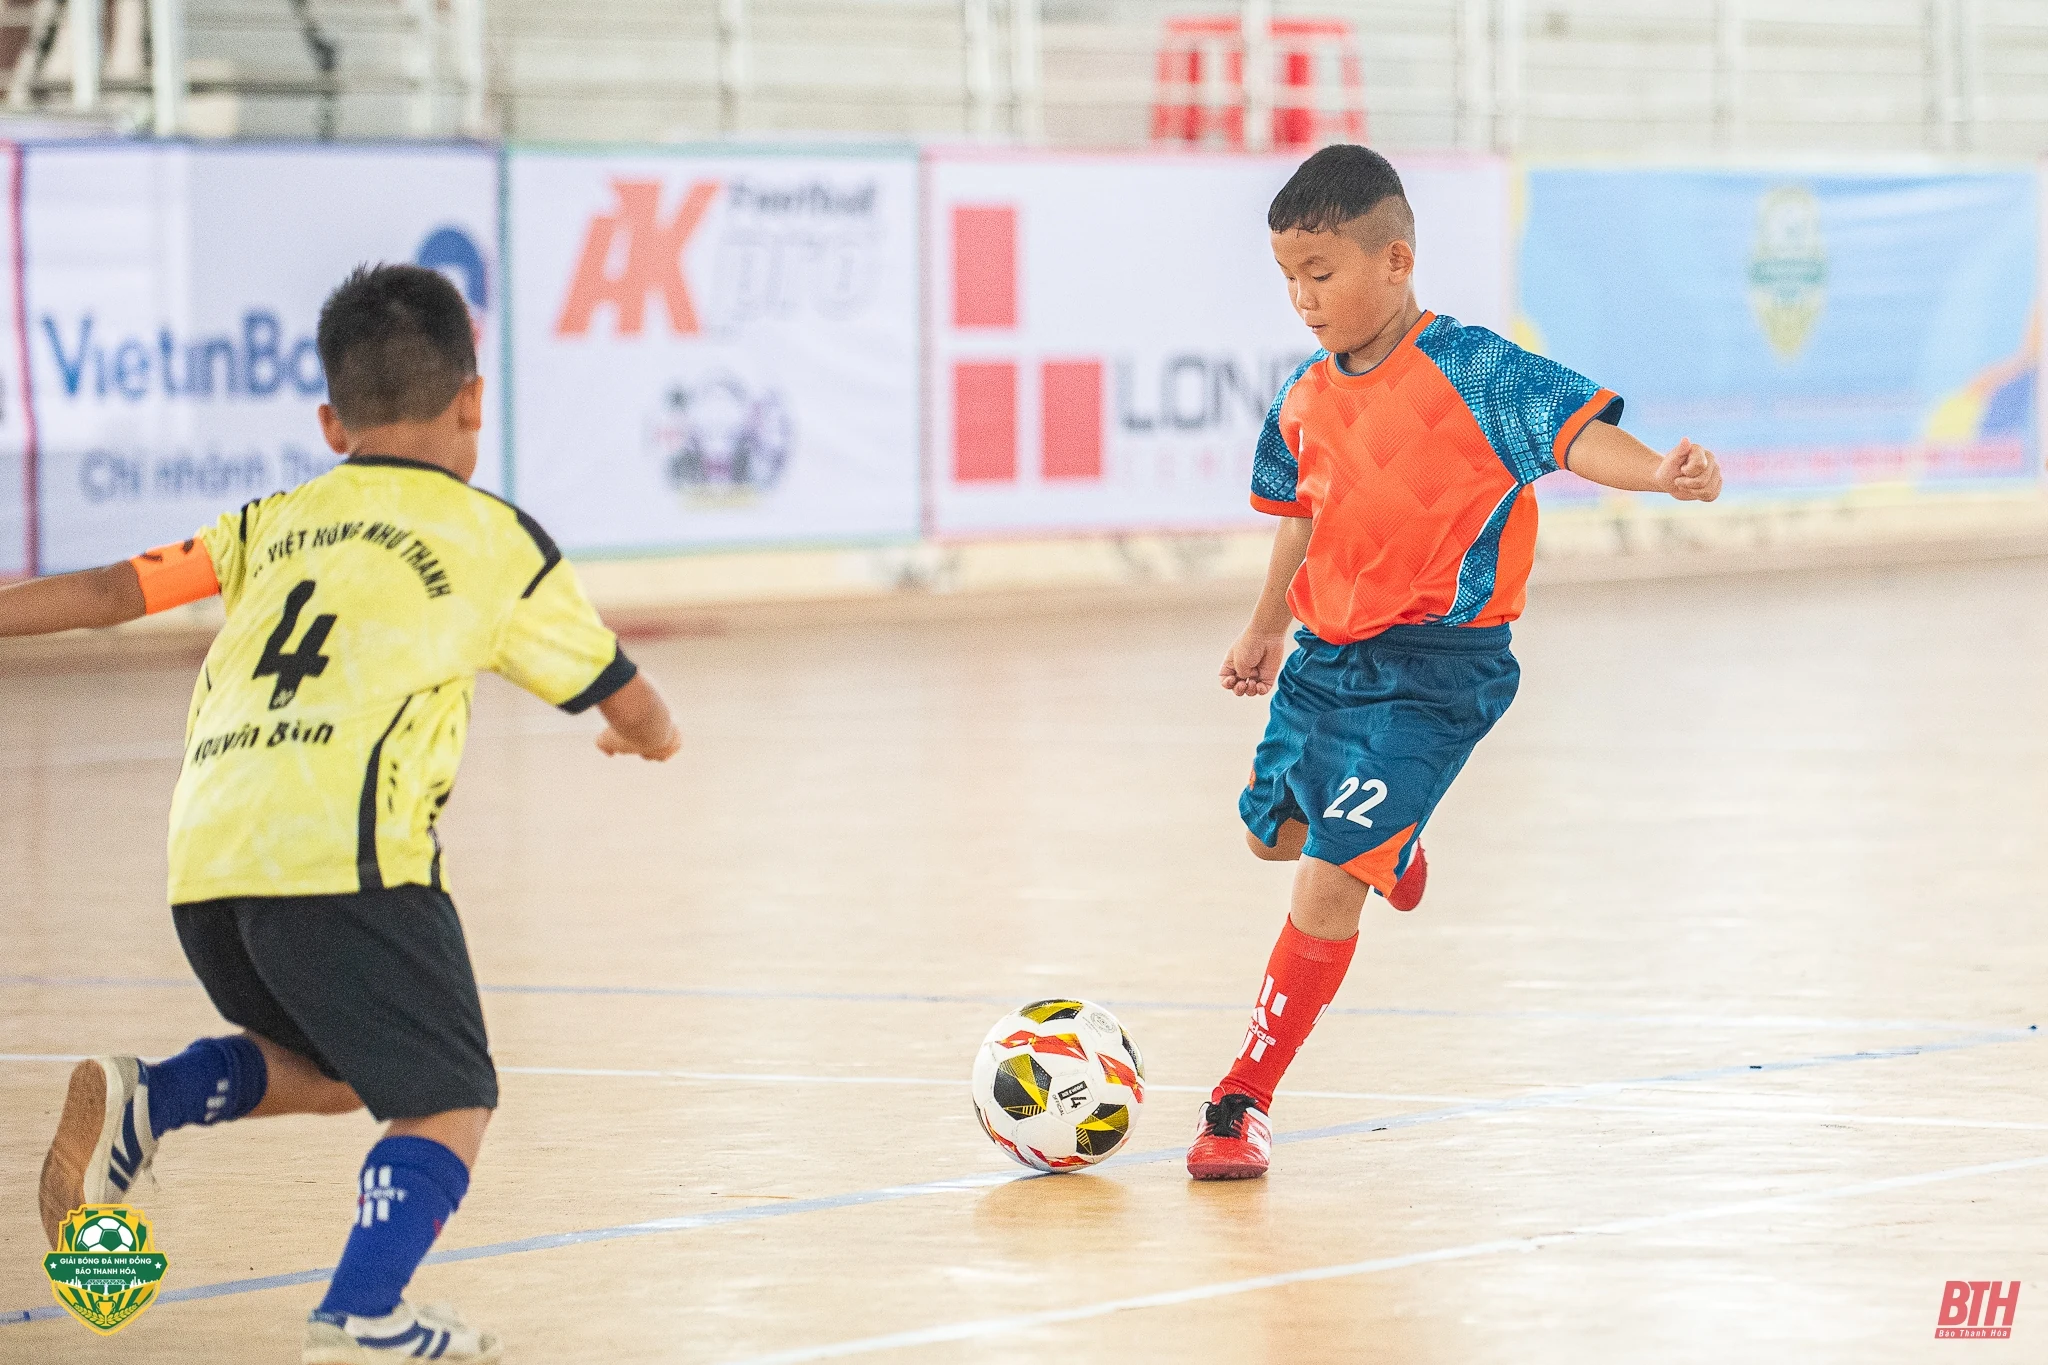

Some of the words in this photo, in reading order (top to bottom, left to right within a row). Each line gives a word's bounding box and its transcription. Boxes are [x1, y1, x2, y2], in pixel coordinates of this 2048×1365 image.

[555, 178, 722, 337] AK
[40, 308, 328, 398] VietinBa
[399, 539, 452, 599] THANH
[251, 579, 338, 711] 4
[1323, 776, 1388, 829] 22
